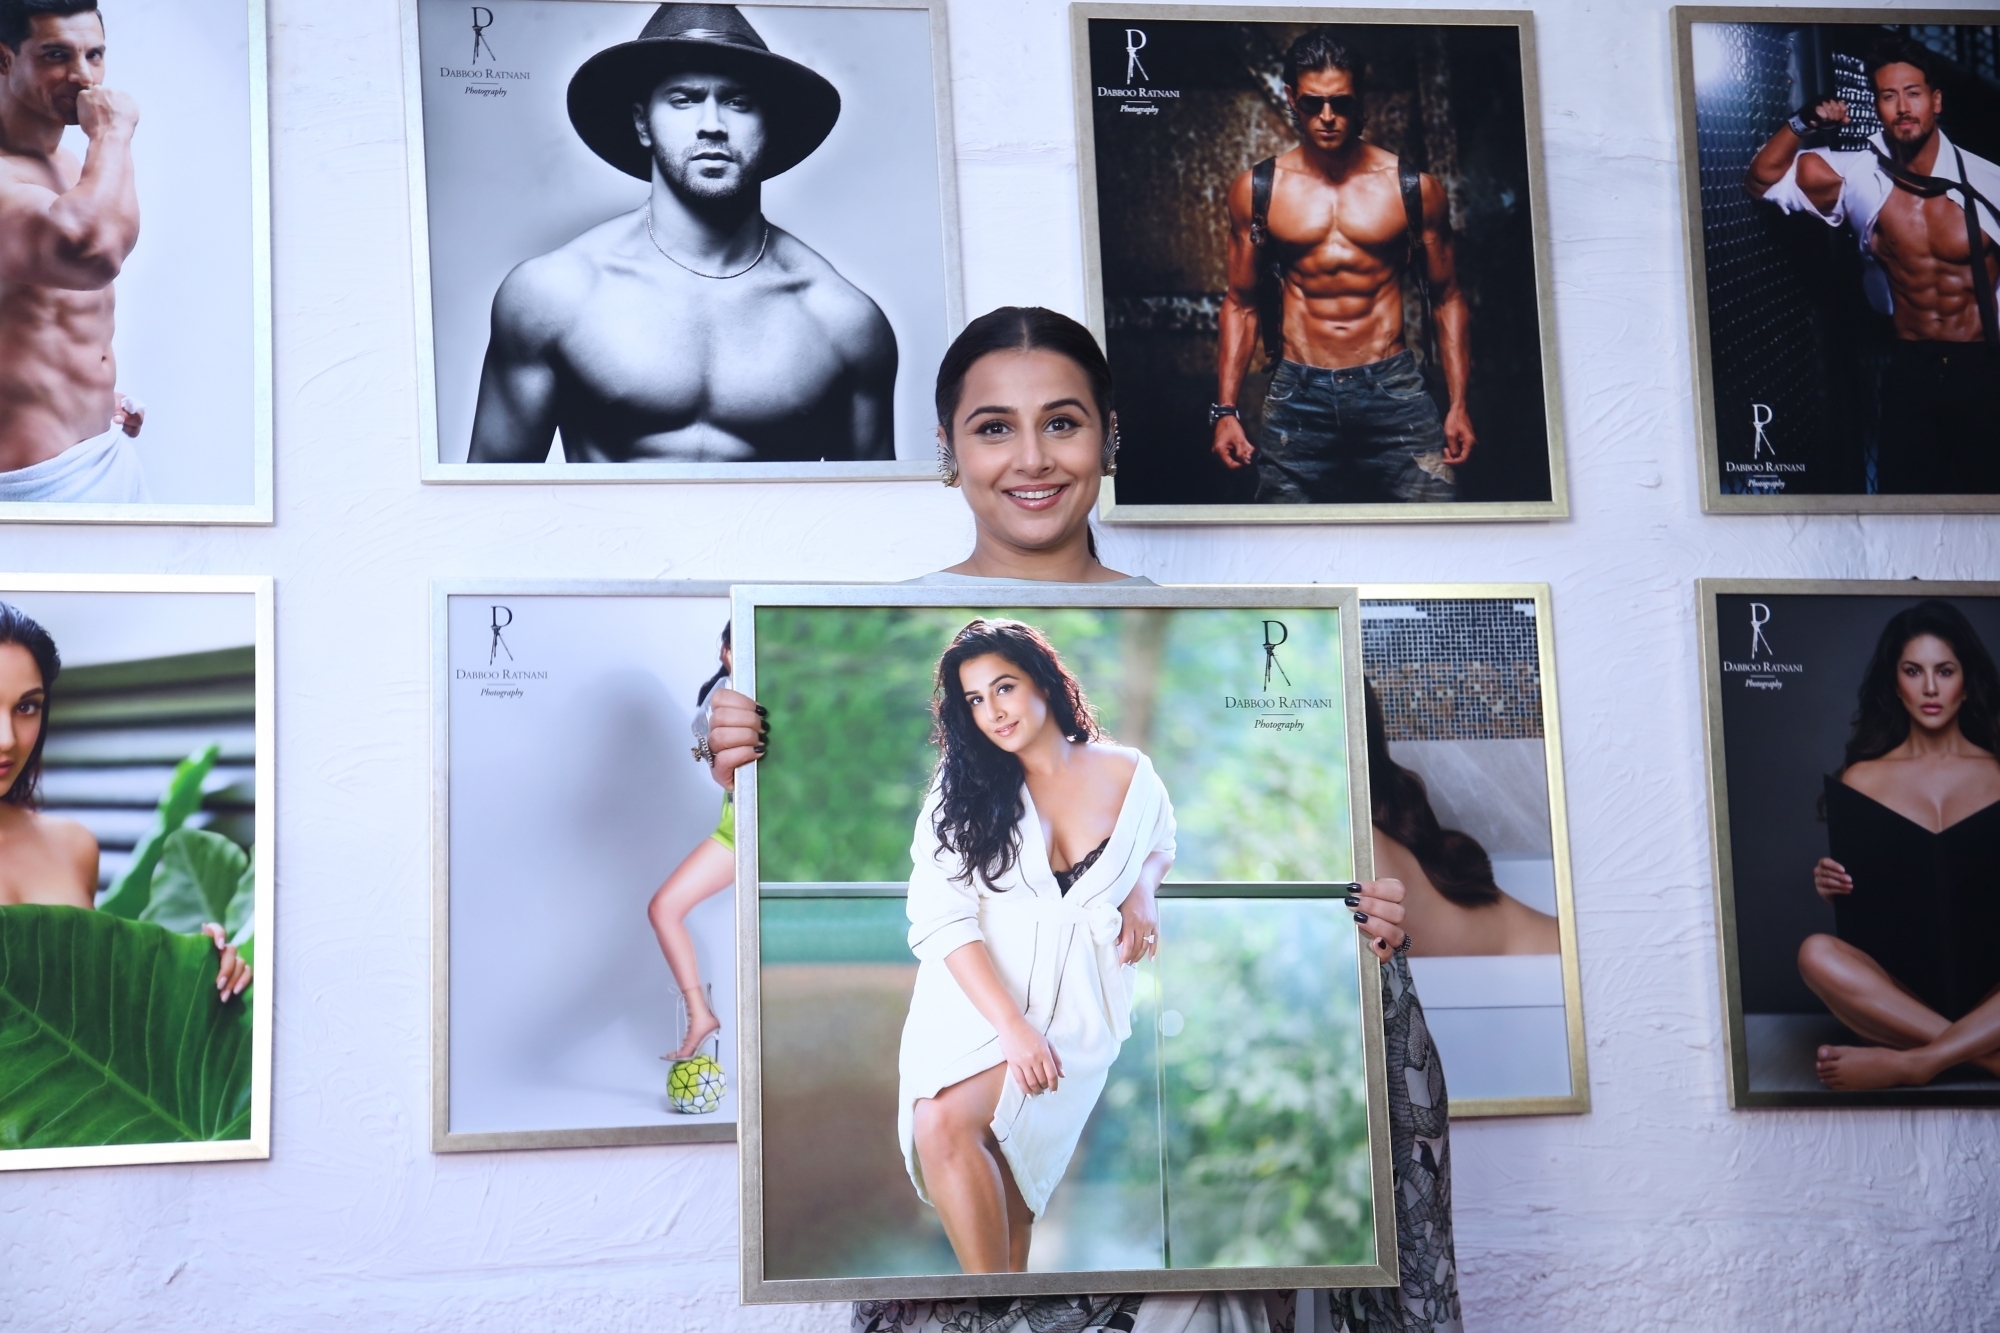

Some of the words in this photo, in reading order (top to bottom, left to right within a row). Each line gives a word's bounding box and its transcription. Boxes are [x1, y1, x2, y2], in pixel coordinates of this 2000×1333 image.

[440, 67, 482, 79] DABBOO
[485, 68, 530, 80] RATNANI
[464, 86, 507, 97] Photography
[1097, 86, 1137, 97] DABBOO
[1138, 87, 1180, 98] RATNANI
[1120, 104, 1159, 115] Photography
[1725, 461, 1764, 472] DABBOO
[1765, 461, 1806, 472] RATNANI
[1747, 478, 1786, 489] Photography
[1723, 661, 1761, 672] DABBOO
[1763, 661, 1803, 672] RATNANI
[456, 669, 499, 680] DABBOO
[502, 669, 548, 680] RATNANI
[1745, 678, 1783, 690] Photography
[480, 687, 524, 698] Photography
[1225, 696, 1275, 709] DABBOO
[1278, 696, 1332, 709] RATNANI
[1254, 719, 1305, 731] Photography
